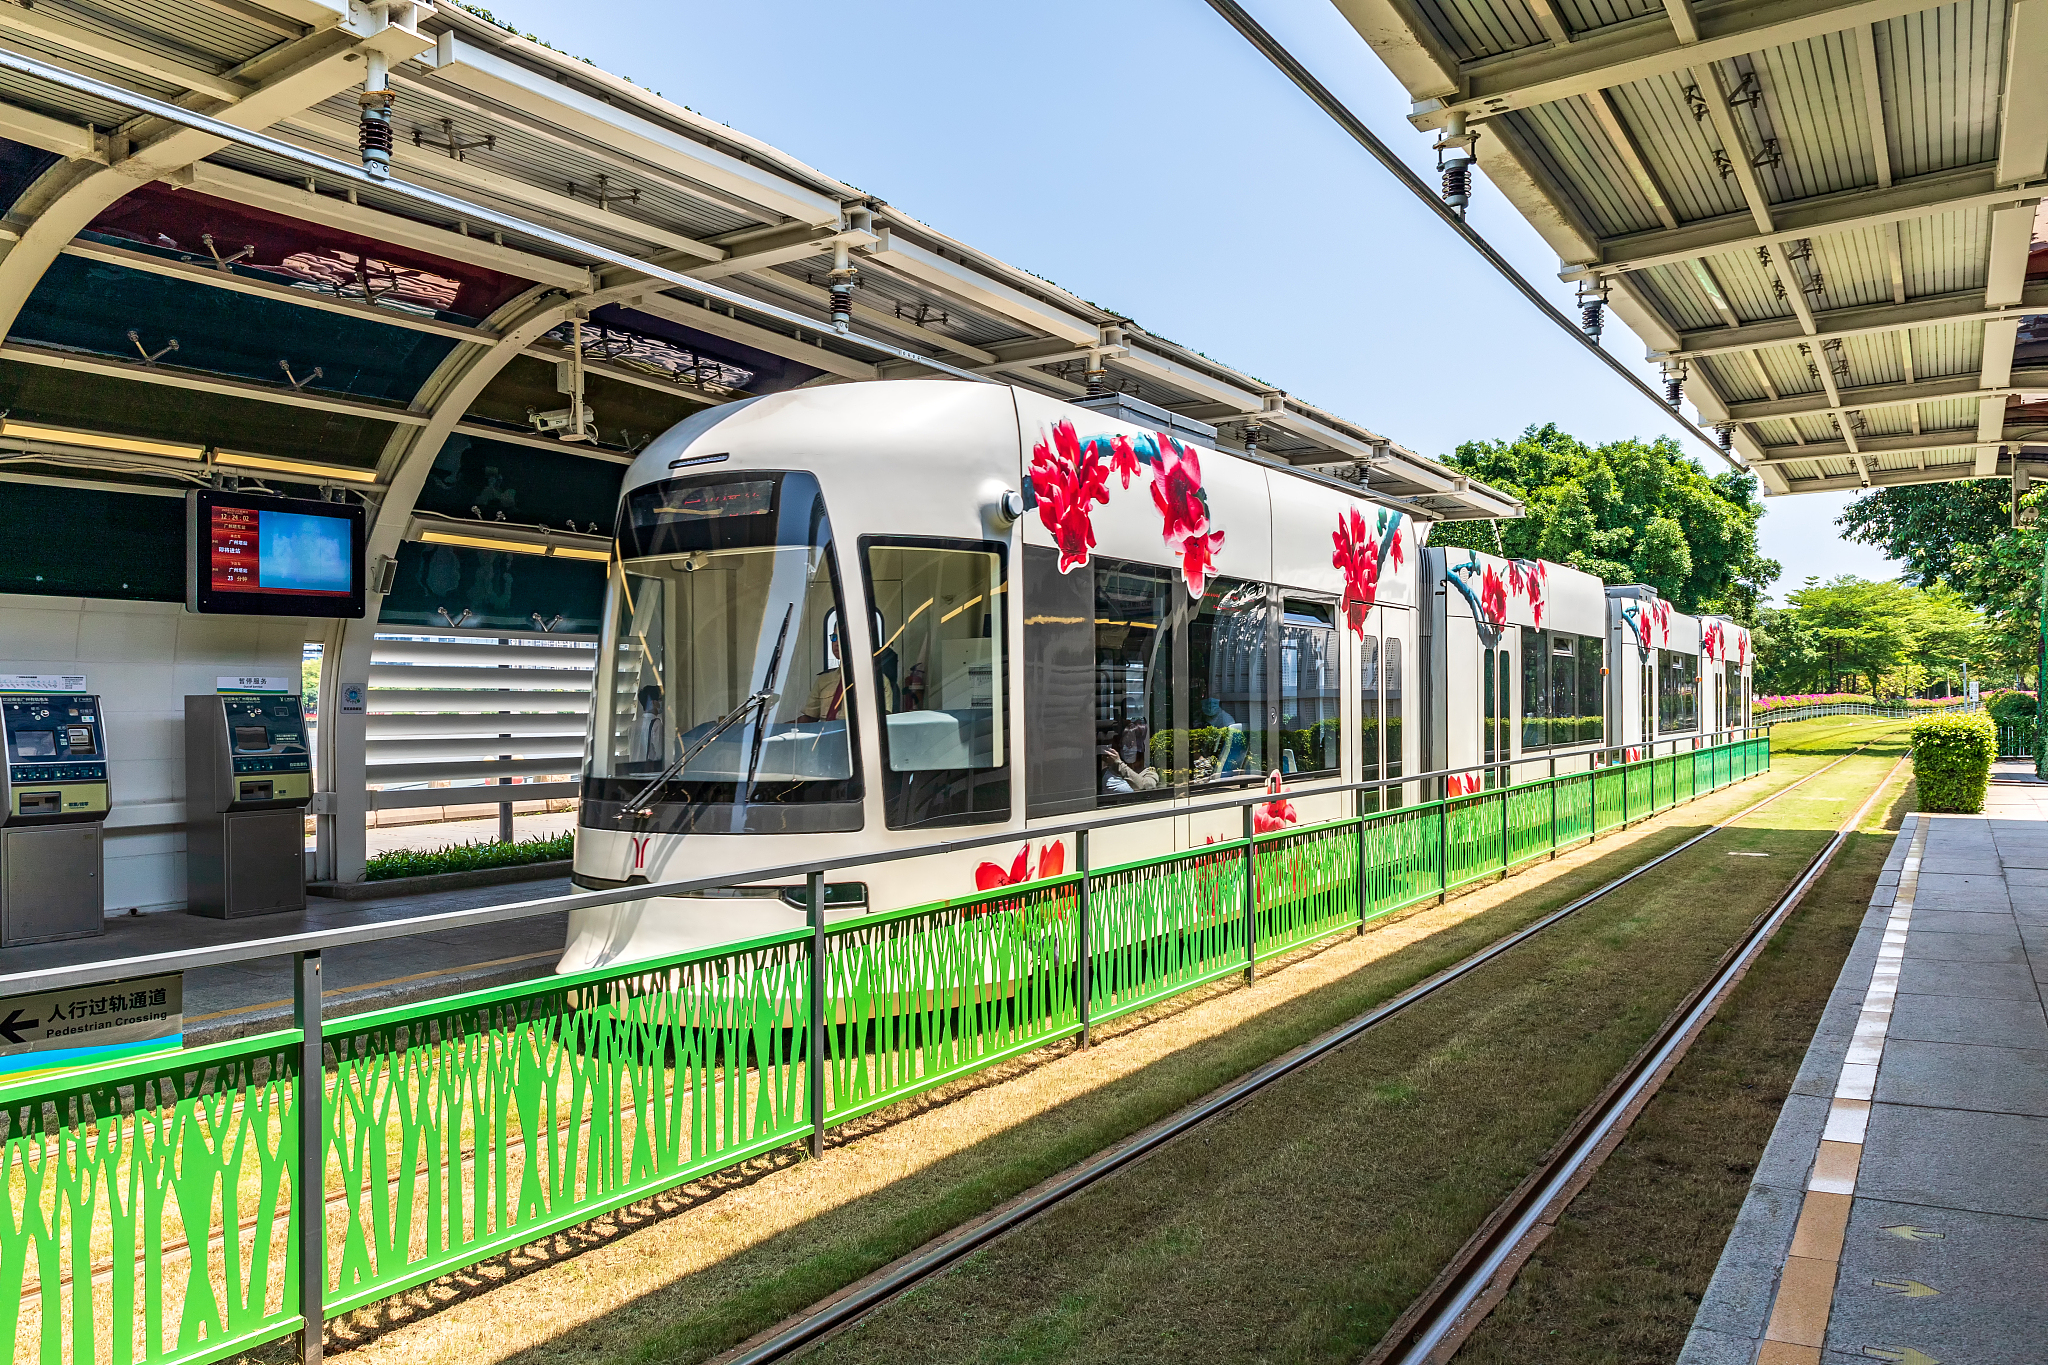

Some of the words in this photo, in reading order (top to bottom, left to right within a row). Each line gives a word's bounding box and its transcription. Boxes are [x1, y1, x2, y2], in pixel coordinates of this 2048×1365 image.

[47, 988, 167, 1023] 人行过轨通道
[47, 1021, 112, 1038] Pedestrian
[115, 1012, 167, 1026] Crossing
